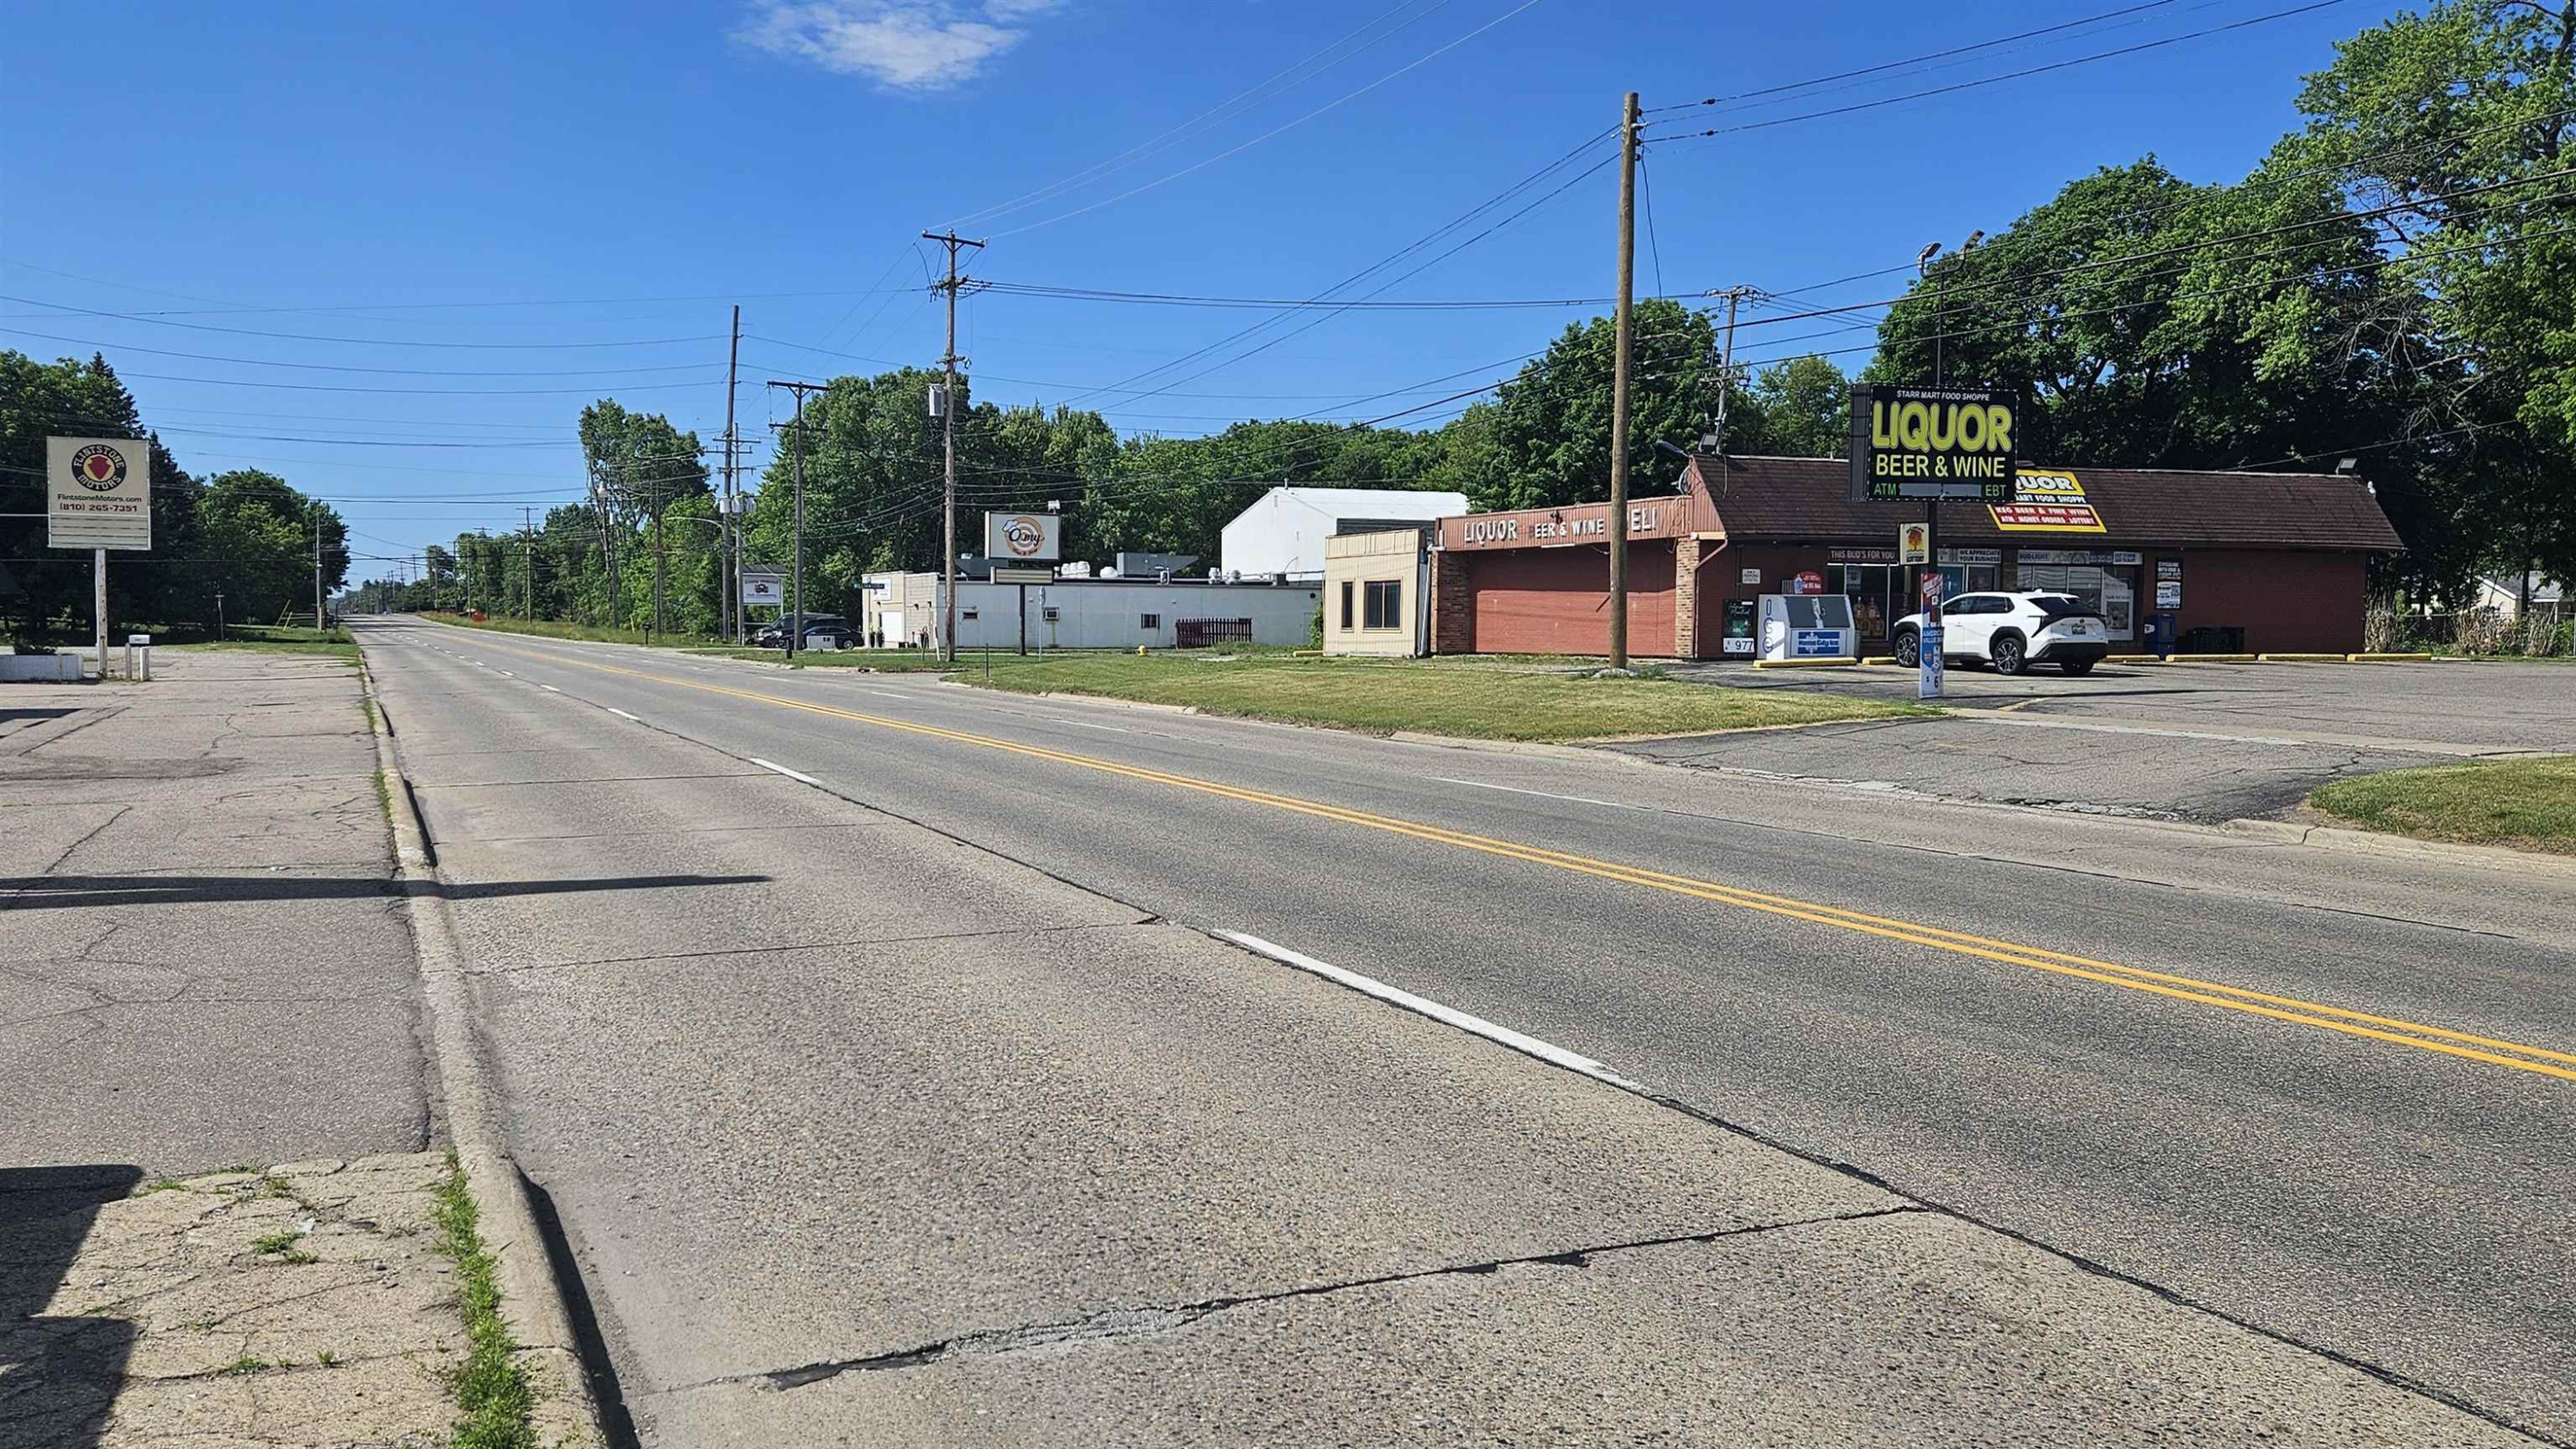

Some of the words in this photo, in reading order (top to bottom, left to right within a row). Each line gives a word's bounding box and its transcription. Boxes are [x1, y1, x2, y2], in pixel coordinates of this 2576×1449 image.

[1897, 390, 1920, 398] STARR
[1921, 391, 1941, 399] MART
[1941, 391, 1961, 400] FOOD
[1962, 392, 1990, 402] SHOPPE
[1872, 400, 2013, 453] LIQUOR
[73, 445, 125, 469] FLINTSTONE
[1876, 453, 1929, 477] BEER
[1935, 455, 1948, 477] &
[1953, 455, 2006, 478] WINE
[77, 474, 122, 490] MOTORS
[1874, 482, 1897, 496] ATM
[1985, 484, 2007, 497] EBT
[58, 494, 142, 503] FlintstoneMotors.com
[2034, 494, 2056, 503] FOOD
[2057, 495, 2087, 504] SHOPPE
[59, 502, 86, 512] (810)
[88, 504, 137, 512] 265-7351
[1463, 519, 1518, 548] LIQUOR
[1559, 521, 1568, 537] &
[1571, 518, 1605, 535] WINE
[1831, 549, 1845, 559] THIS
[1847, 550, 1867, 560] BUD'S
[1868, 550, 1880, 560] FOR
[1881, 550, 1895, 560] YOU
